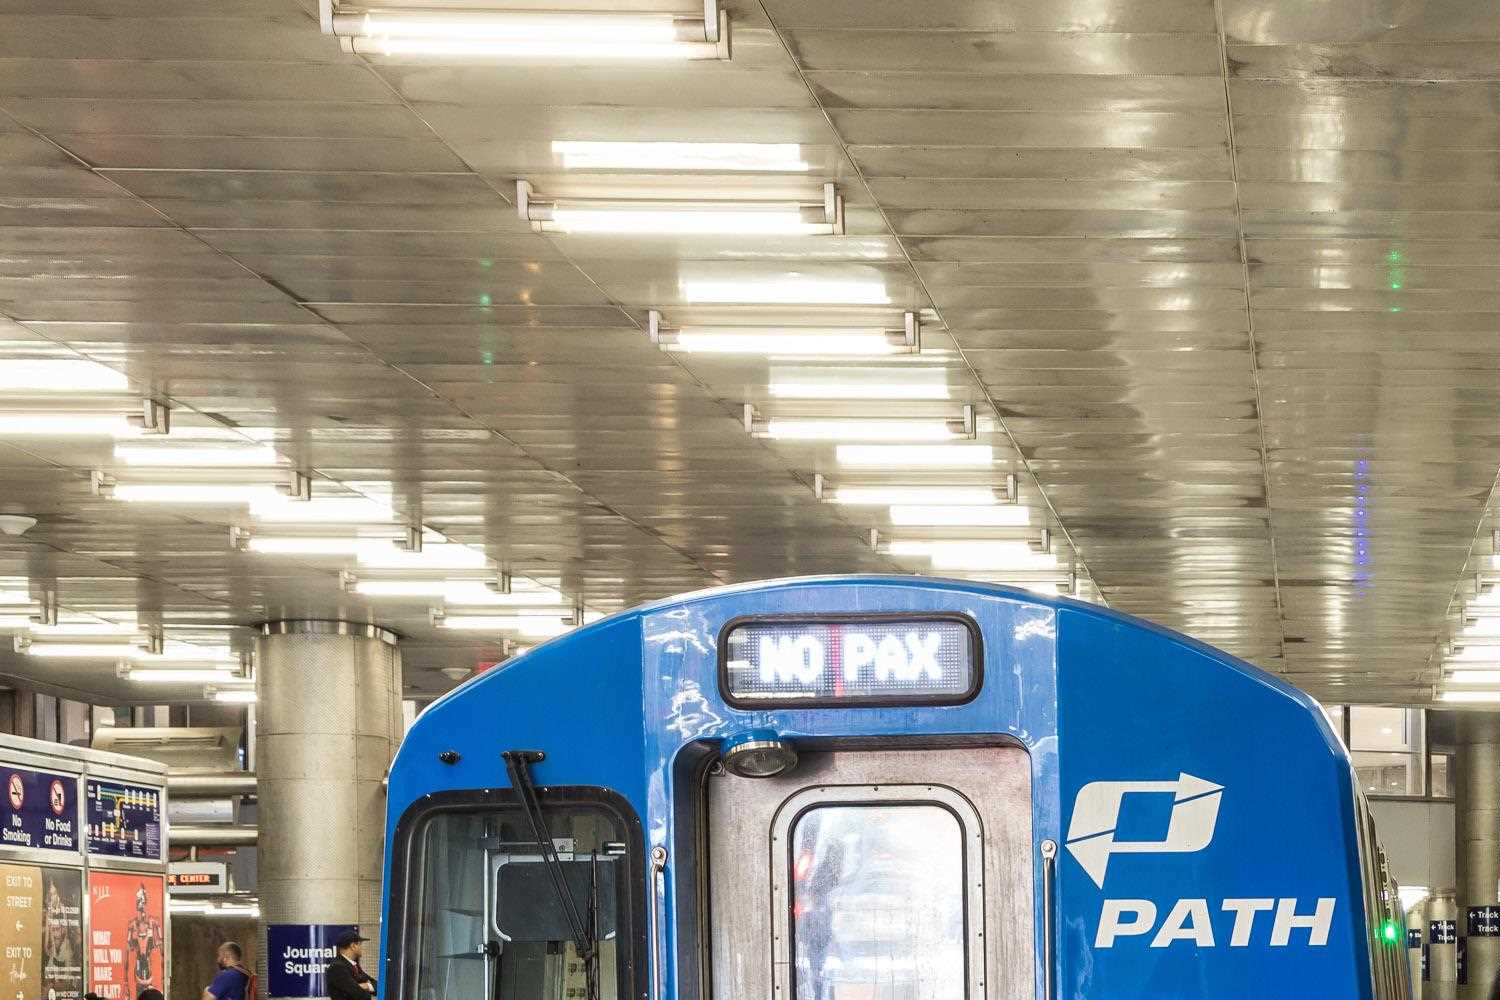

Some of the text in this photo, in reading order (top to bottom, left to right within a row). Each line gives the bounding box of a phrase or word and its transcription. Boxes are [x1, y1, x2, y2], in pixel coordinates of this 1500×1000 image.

[759, 630, 943, 683] NO PAX
[12, 814, 22, 828] No
[45, 818, 71, 832] No Food
[3, 828, 31, 846] Smoking
[44, 833, 72, 847] or Drinks
[6, 875, 32, 888] EXIT TO
[180, 875, 210, 883] CENTER
[6, 896, 32, 908] STREET
[1477, 911, 1499, 919] Track
[1094, 897, 1337, 949] PATH
[1477, 924, 1499, 932] Track
[93, 931, 112, 945] WHAT
[6, 946, 32, 959] EXIT TO
[93, 948, 122, 964] WILL YOU
[283, 945, 338, 959] Journal
[94, 966, 113, 981] MAKE
[285, 961, 331, 977] Squar
